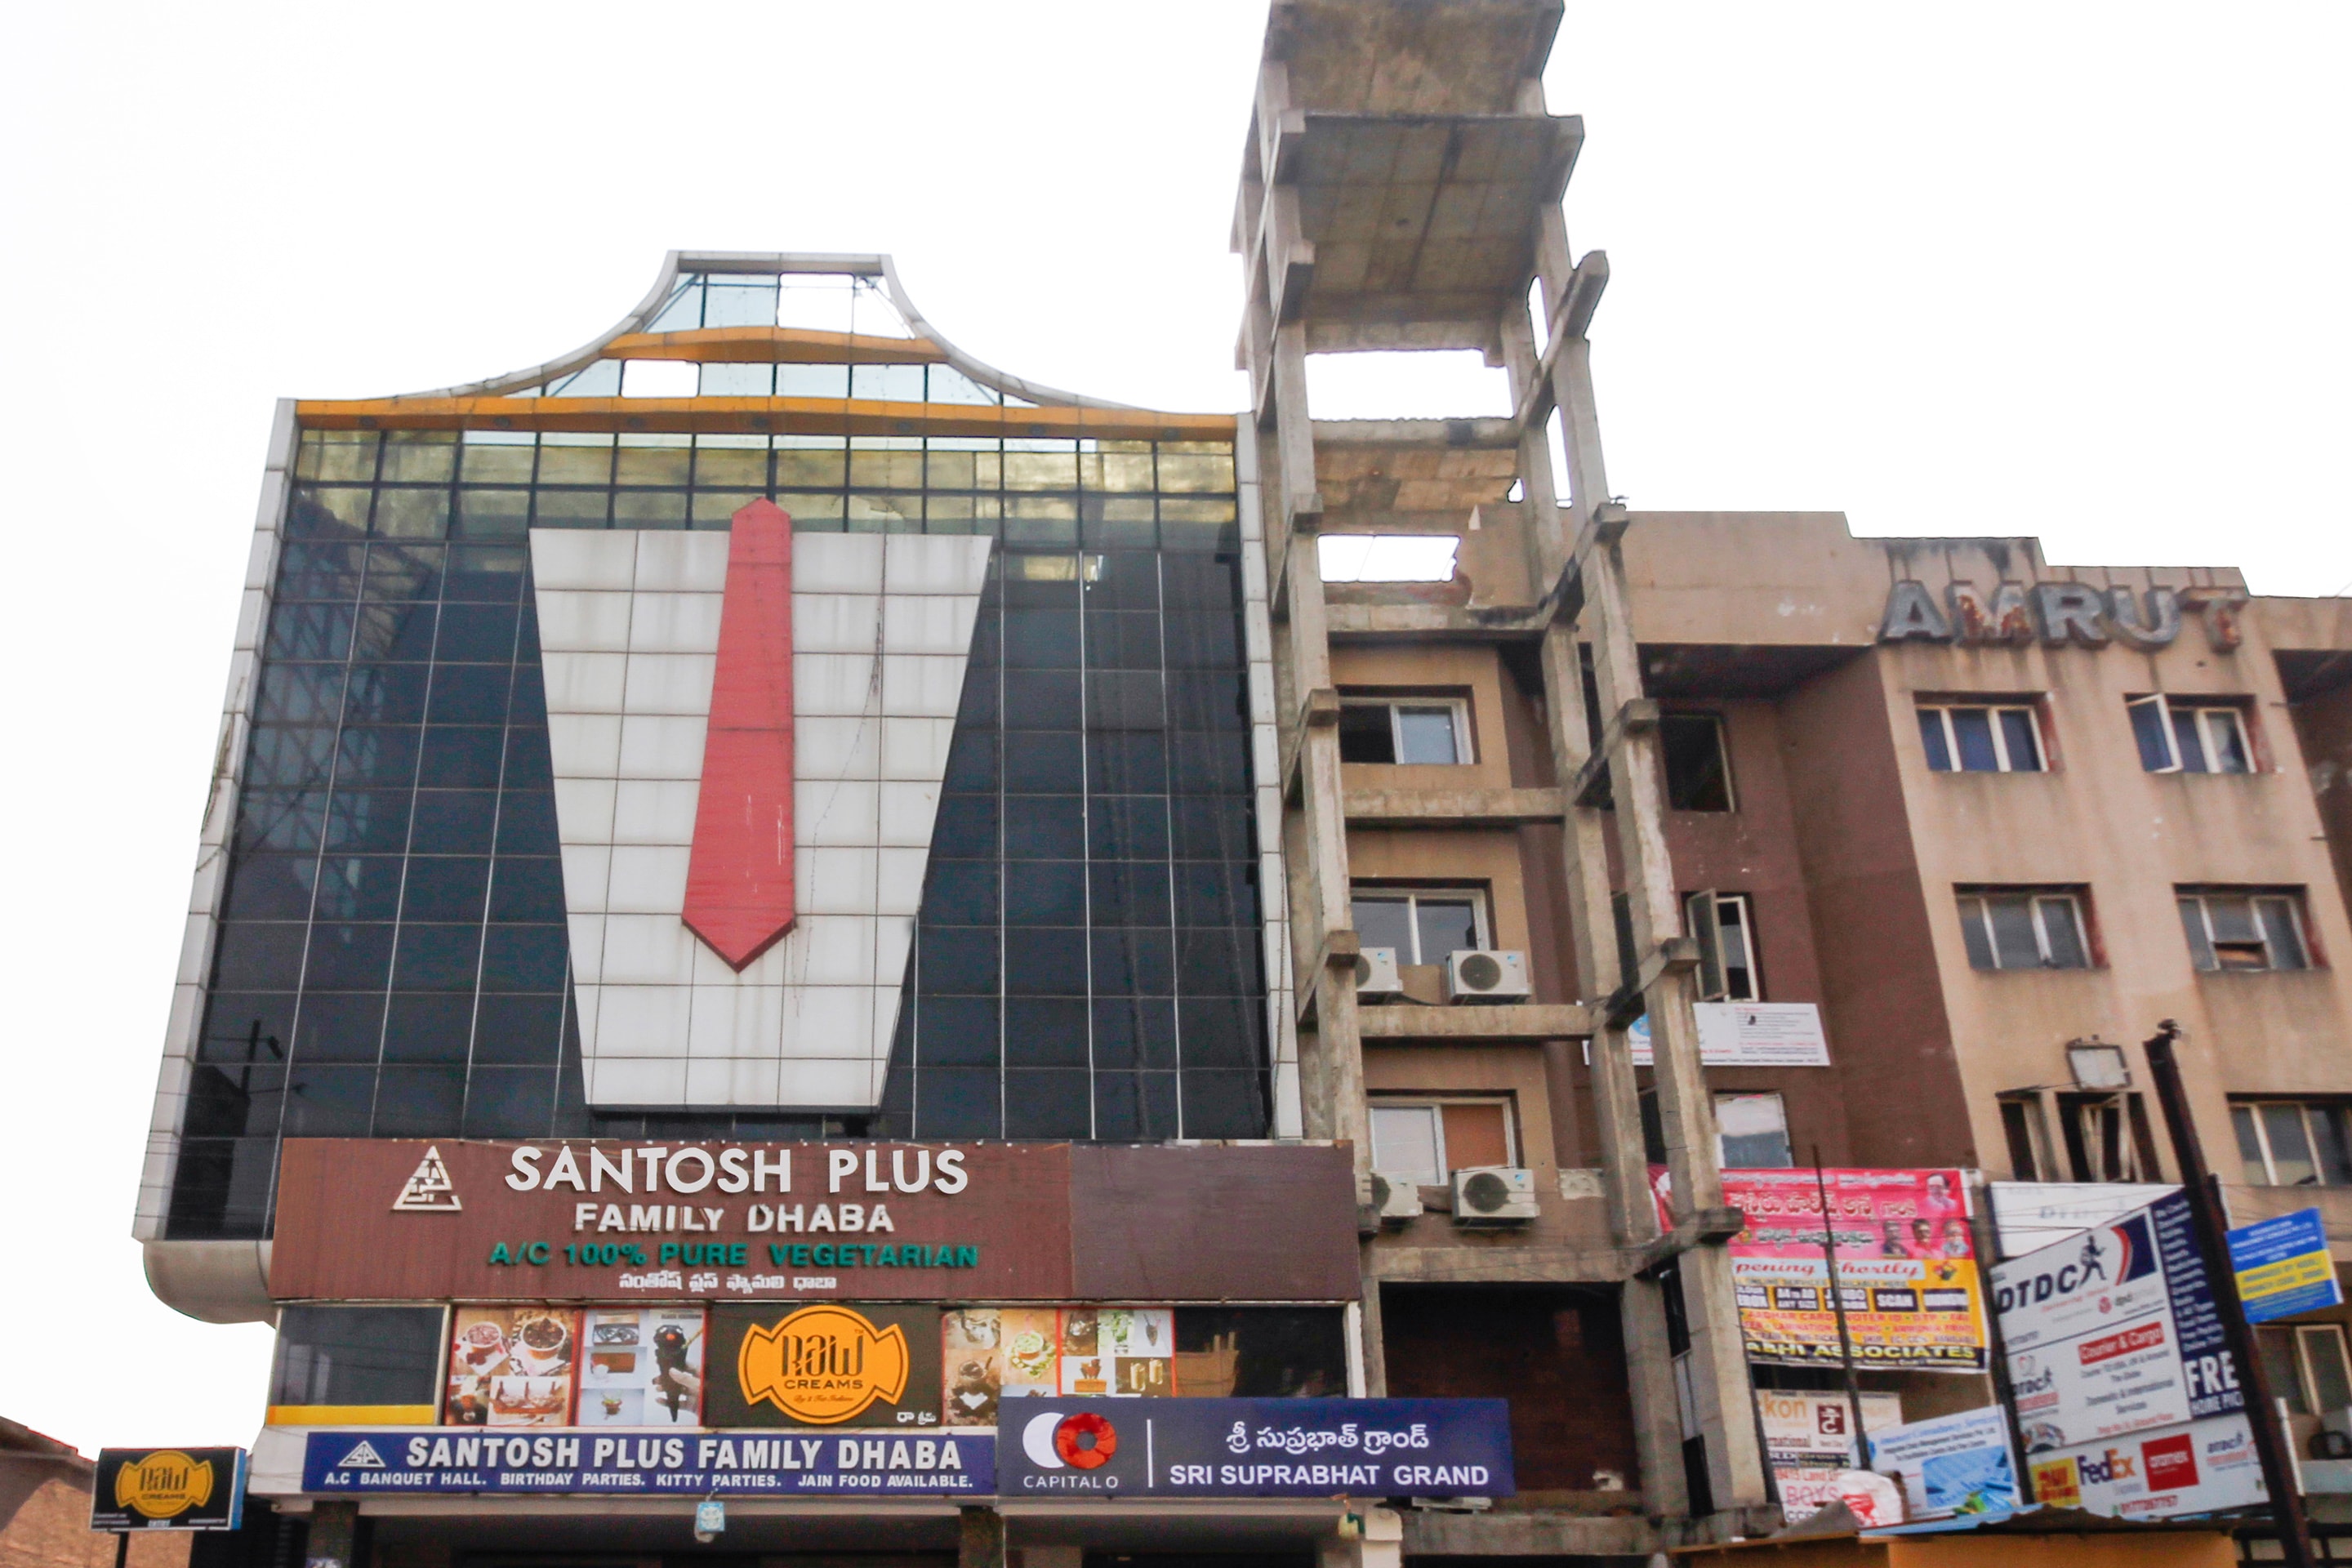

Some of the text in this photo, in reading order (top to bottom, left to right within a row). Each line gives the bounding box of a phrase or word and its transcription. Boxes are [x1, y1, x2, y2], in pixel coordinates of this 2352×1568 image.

[1878, 579, 2249, 653] AMRUT
[505, 1145, 969, 1194] SANTOSH PLUS
[575, 1202, 894, 1232] FAMILY DHABA
[490, 1241, 978, 1267] A/C 100% PURE VEGETARIAN
[1735, 1262, 1918, 1276] pening hortly
[1877, 1294, 1913, 1307] SCAN
[1998, 1264, 2078, 1314] DTDC
[1814, 1344, 1976, 1359] ASSOCIATES
[784, 1379, 863, 1390] CREAMS
[2185, 1350, 2240, 1399] FRE
[1759, 1392, 1807, 1419] kon
[1226, 1421, 1430, 1455] శ్రీ సుప్రభాత్ గ్రాండ్
[1766, 1433, 1811, 1448] rnational
[407, 1437, 962, 1469] SANTOSH PLUS FAMILY DHABA
[324, 1472, 973, 1488] A.C BANQUET HALL. BIRTHDAY PARTIES. KITTY PARTIES. JAIN FOOD AVAILABLE.
[1170, 1465, 1490, 1486] SRI SUPRABHAT GRAND
[2077, 1448, 2136, 1486] FedEx
[1785, 1486, 1838, 1507] BOYS
